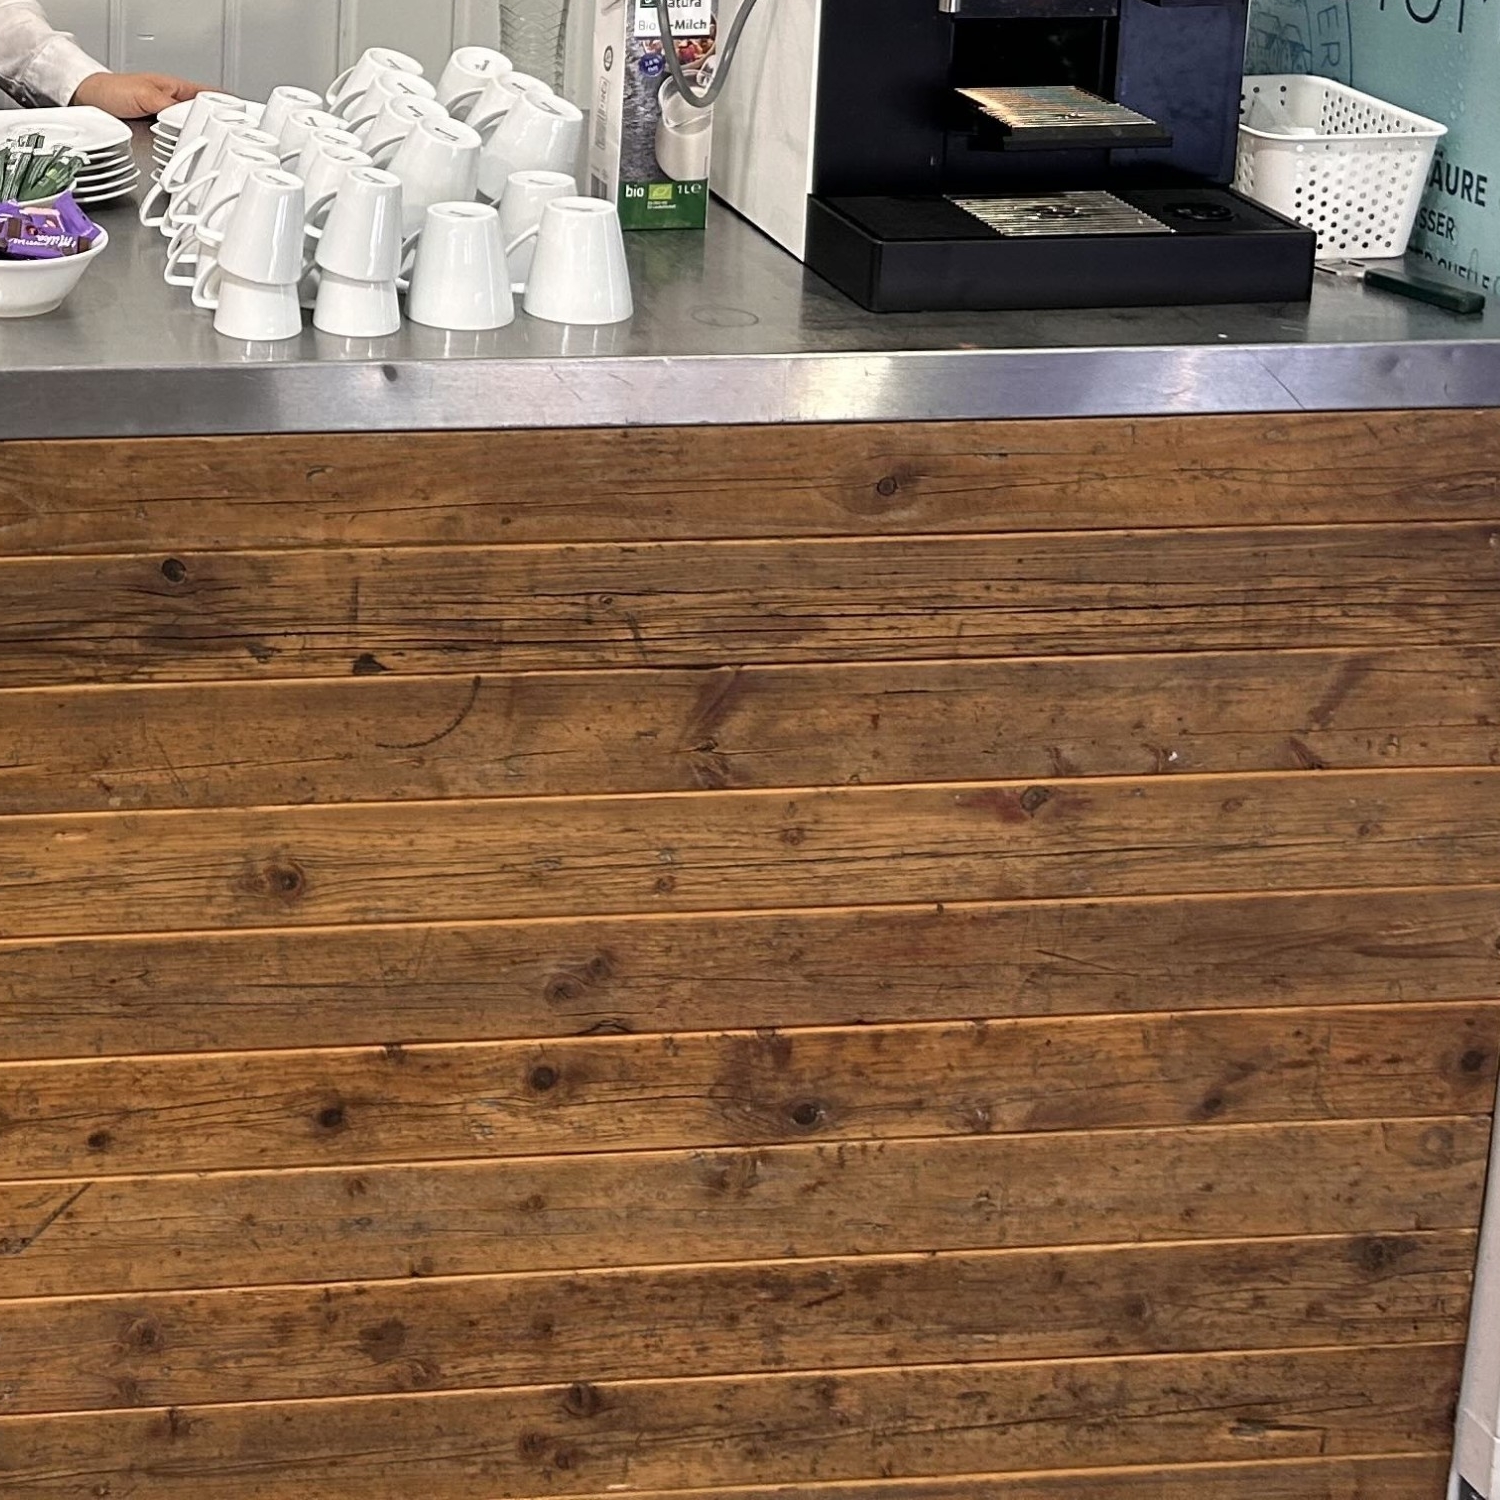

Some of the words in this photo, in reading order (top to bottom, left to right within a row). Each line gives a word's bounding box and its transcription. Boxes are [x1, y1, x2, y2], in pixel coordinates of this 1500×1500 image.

[638, 20, 657, 31] Bio
[668, 19, 707, 30] -Milch
[625, 183, 645, 198] bio
[1429, 148, 1488, 208] ÄURE
[1414, 206, 1455, 242] SSER
